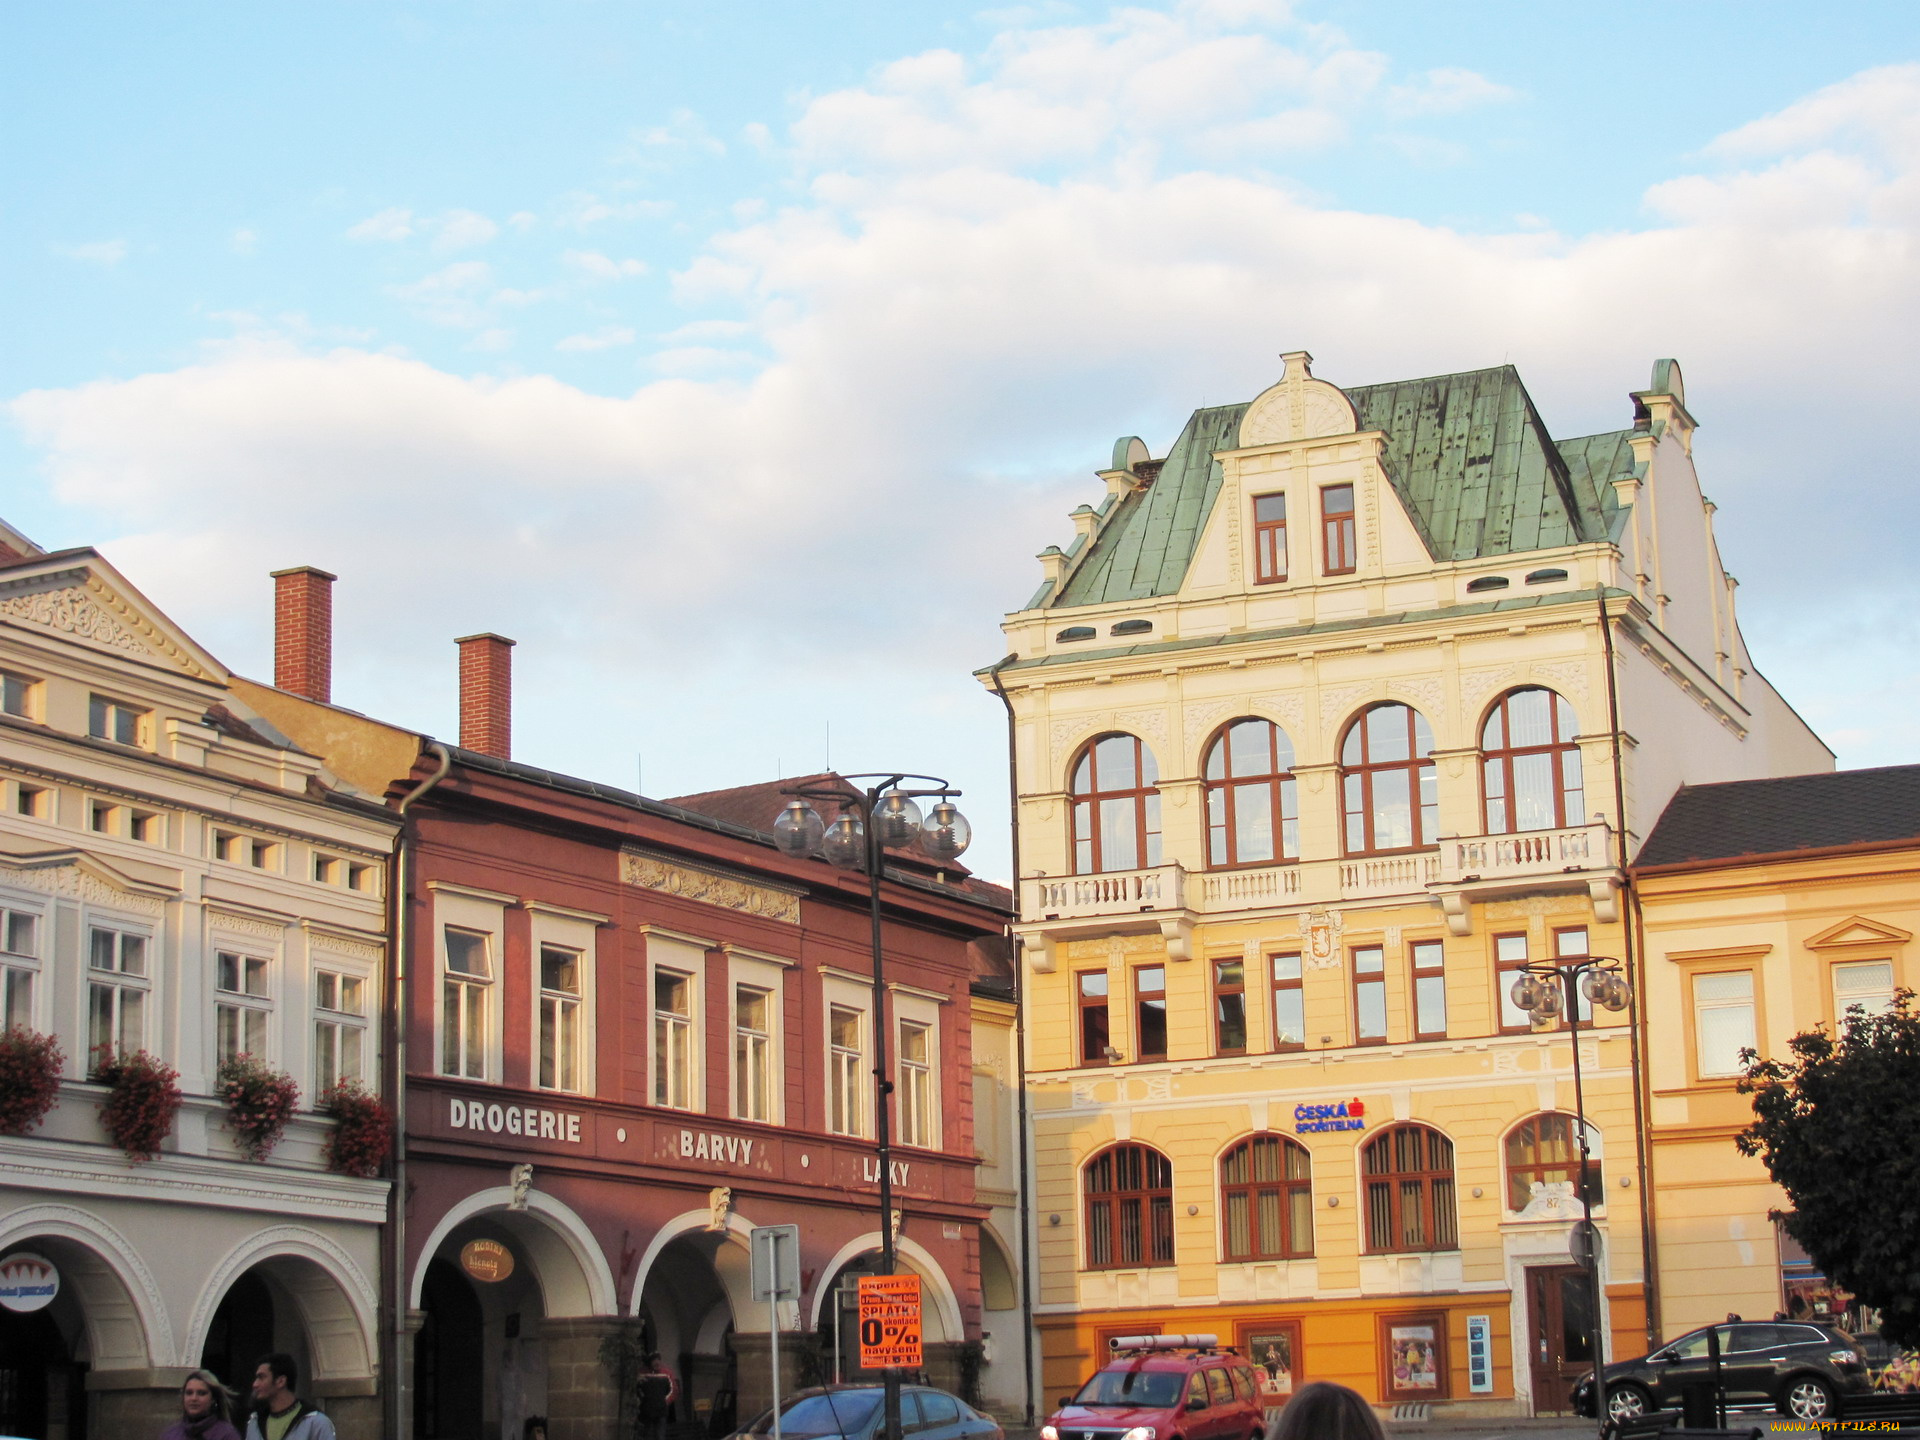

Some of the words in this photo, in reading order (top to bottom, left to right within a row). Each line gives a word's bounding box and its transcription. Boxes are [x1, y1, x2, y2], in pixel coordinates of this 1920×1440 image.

[1294, 1101, 1349, 1121] ČESKÁ
[450, 1098, 581, 1143] DROGERIE
[1295, 1118, 1365, 1134] SPOŘITELNA
[680, 1130, 753, 1165] BARVY
[861, 1282, 900, 1290] expert
[884, 1318, 919, 1326] akontace
[864, 1345, 917, 1355] navýšení
